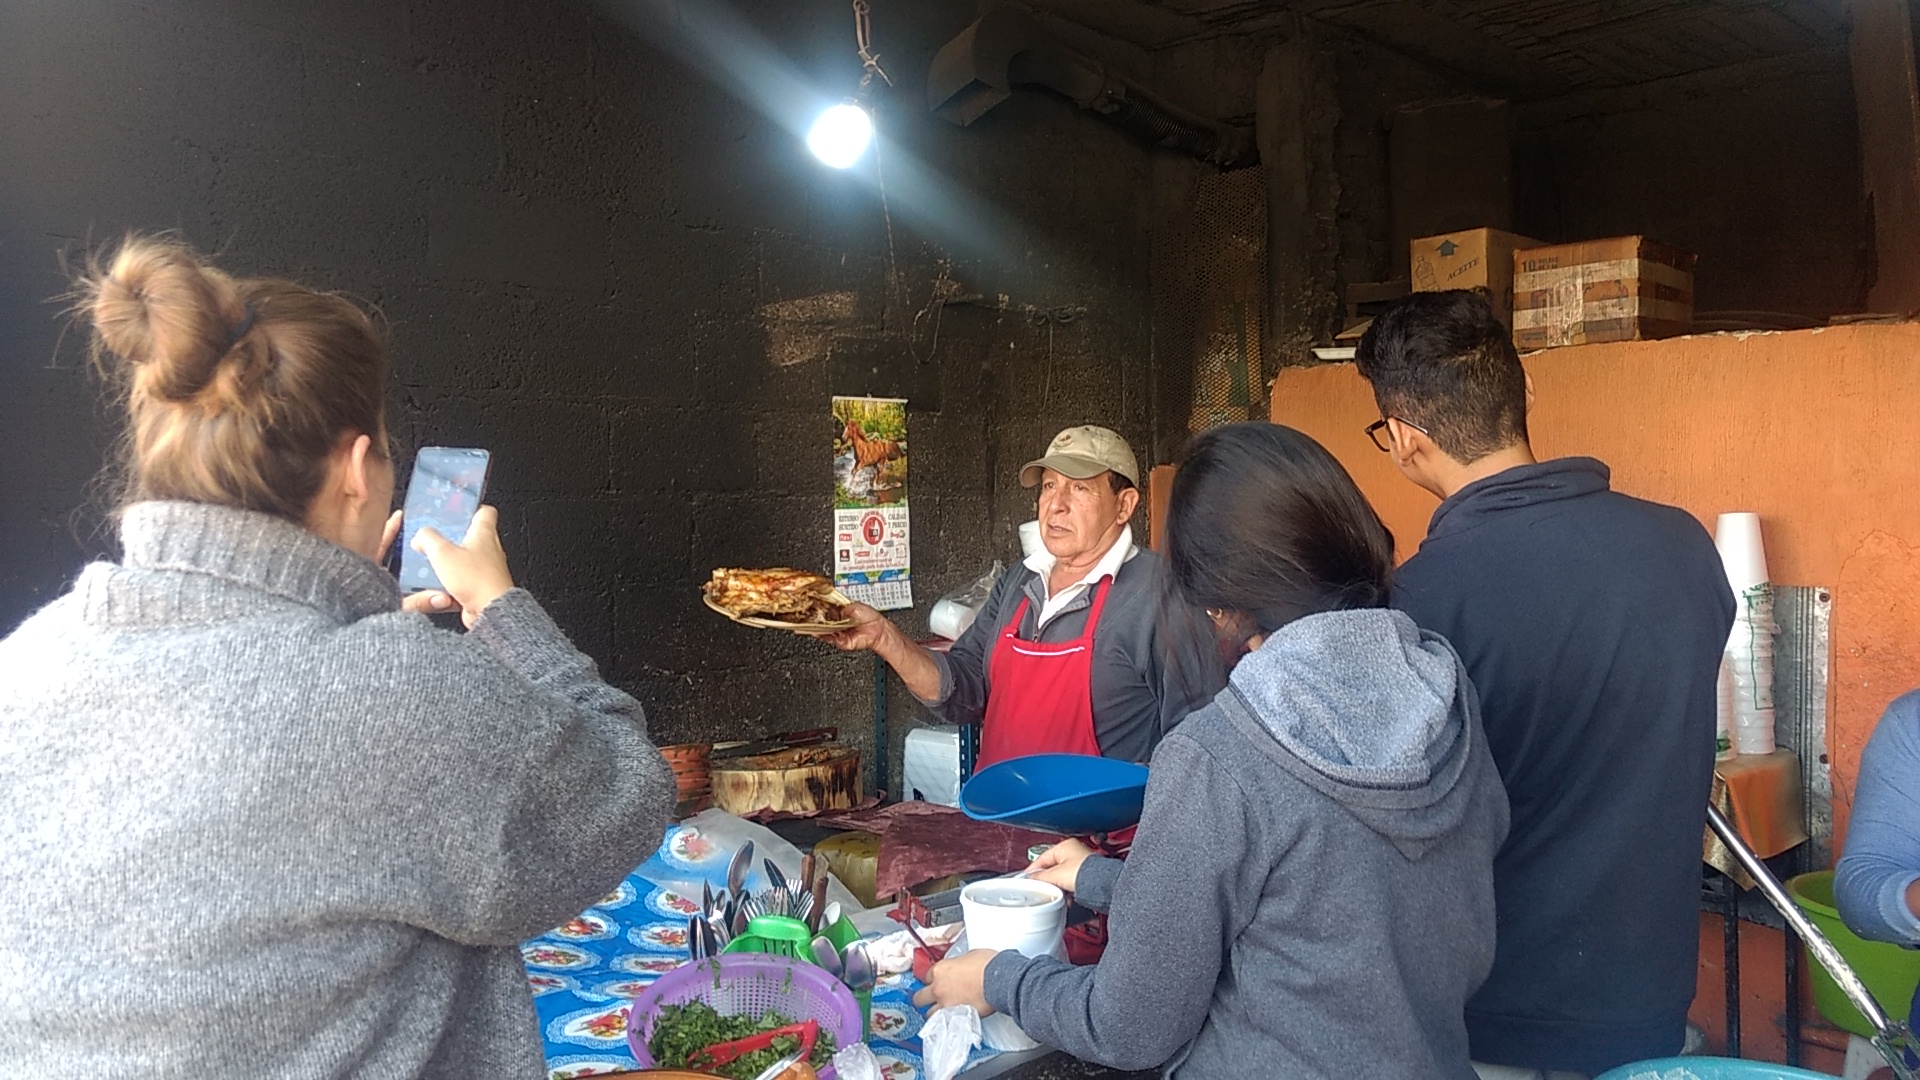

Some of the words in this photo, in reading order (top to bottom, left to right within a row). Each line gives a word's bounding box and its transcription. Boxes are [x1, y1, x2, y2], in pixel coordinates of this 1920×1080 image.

[1447, 257, 1479, 282] ACEITE
[1521, 259, 1535, 273] 10
[838, 523, 858, 531] SURTIDO
